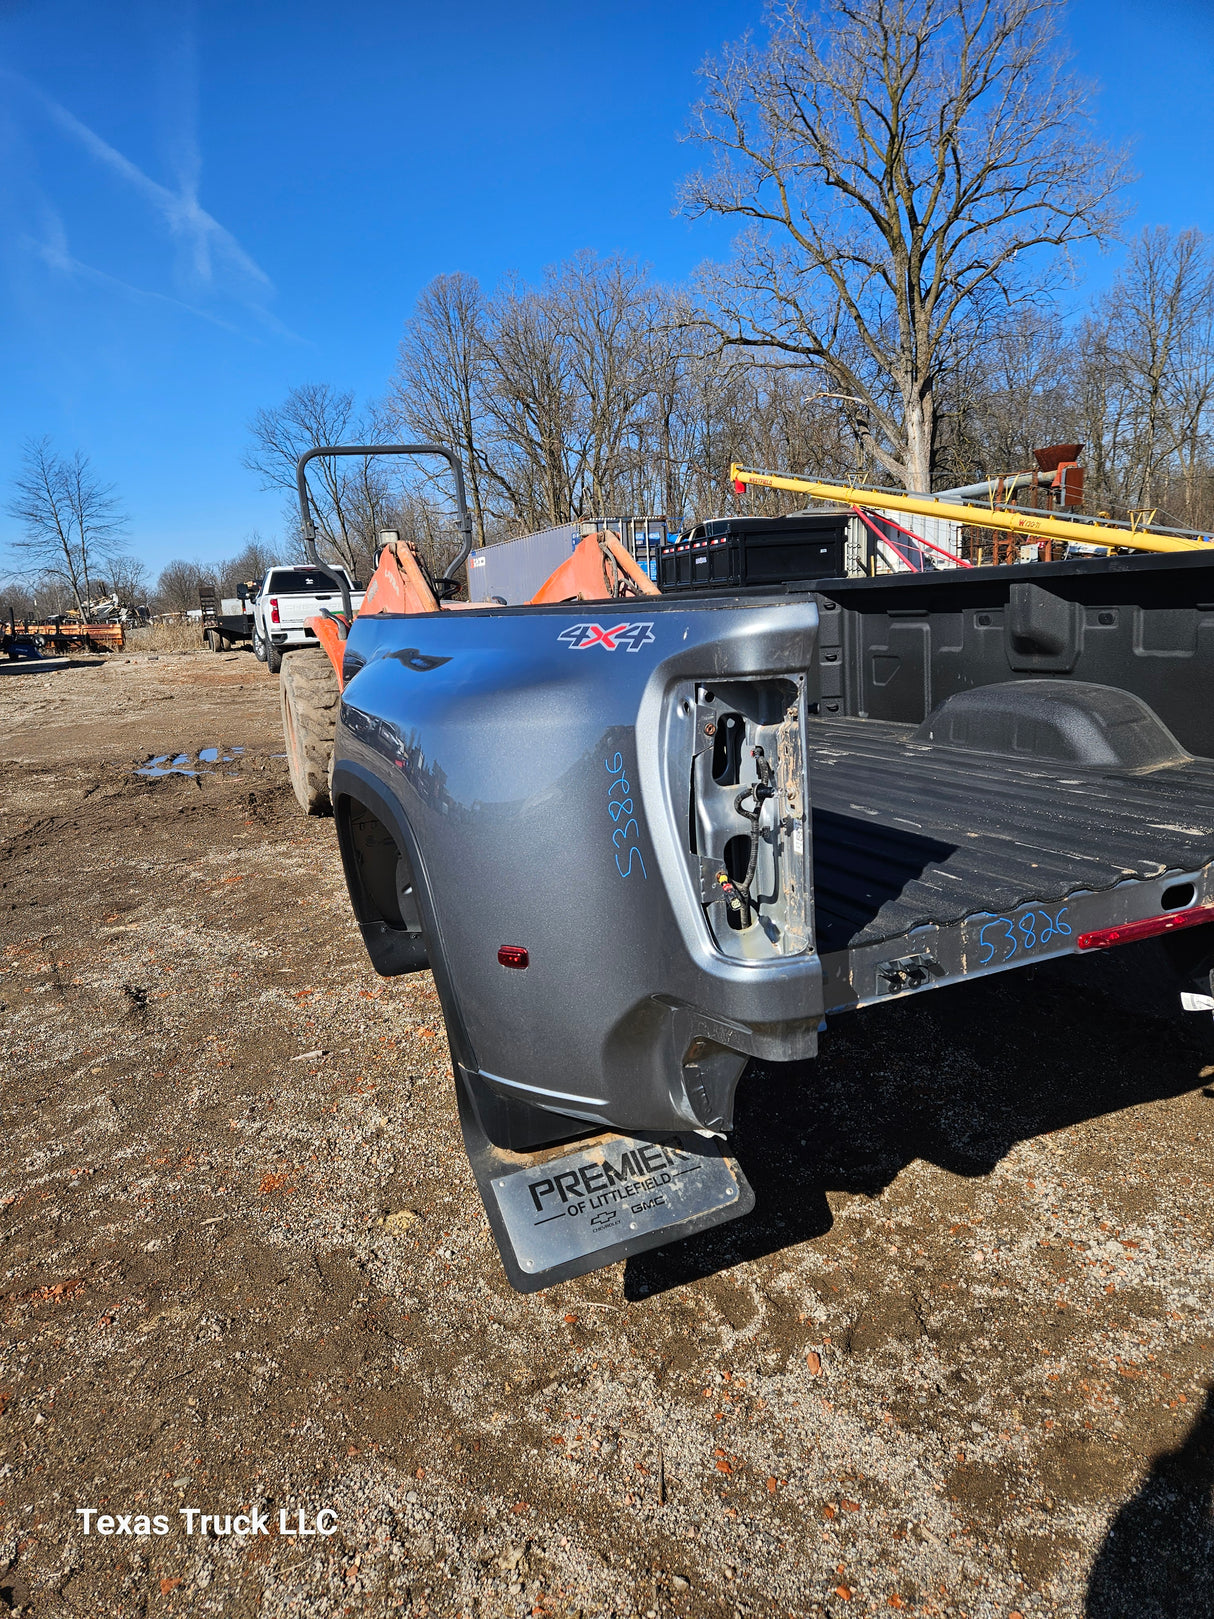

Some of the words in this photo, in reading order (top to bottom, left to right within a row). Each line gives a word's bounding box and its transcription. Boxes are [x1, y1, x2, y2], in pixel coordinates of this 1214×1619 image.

[605, 751, 648, 880] 53826
[980, 907, 1072, 963] 53826
[528, 1136, 689, 1212] PREMIER
[567, 1201, 587, 1217] OF
[589, 1172, 672, 1210] LITTLEFIELD
[592, 1219, 622, 1233] CHEVROLET
[631, 1195, 666, 1214] GMC
